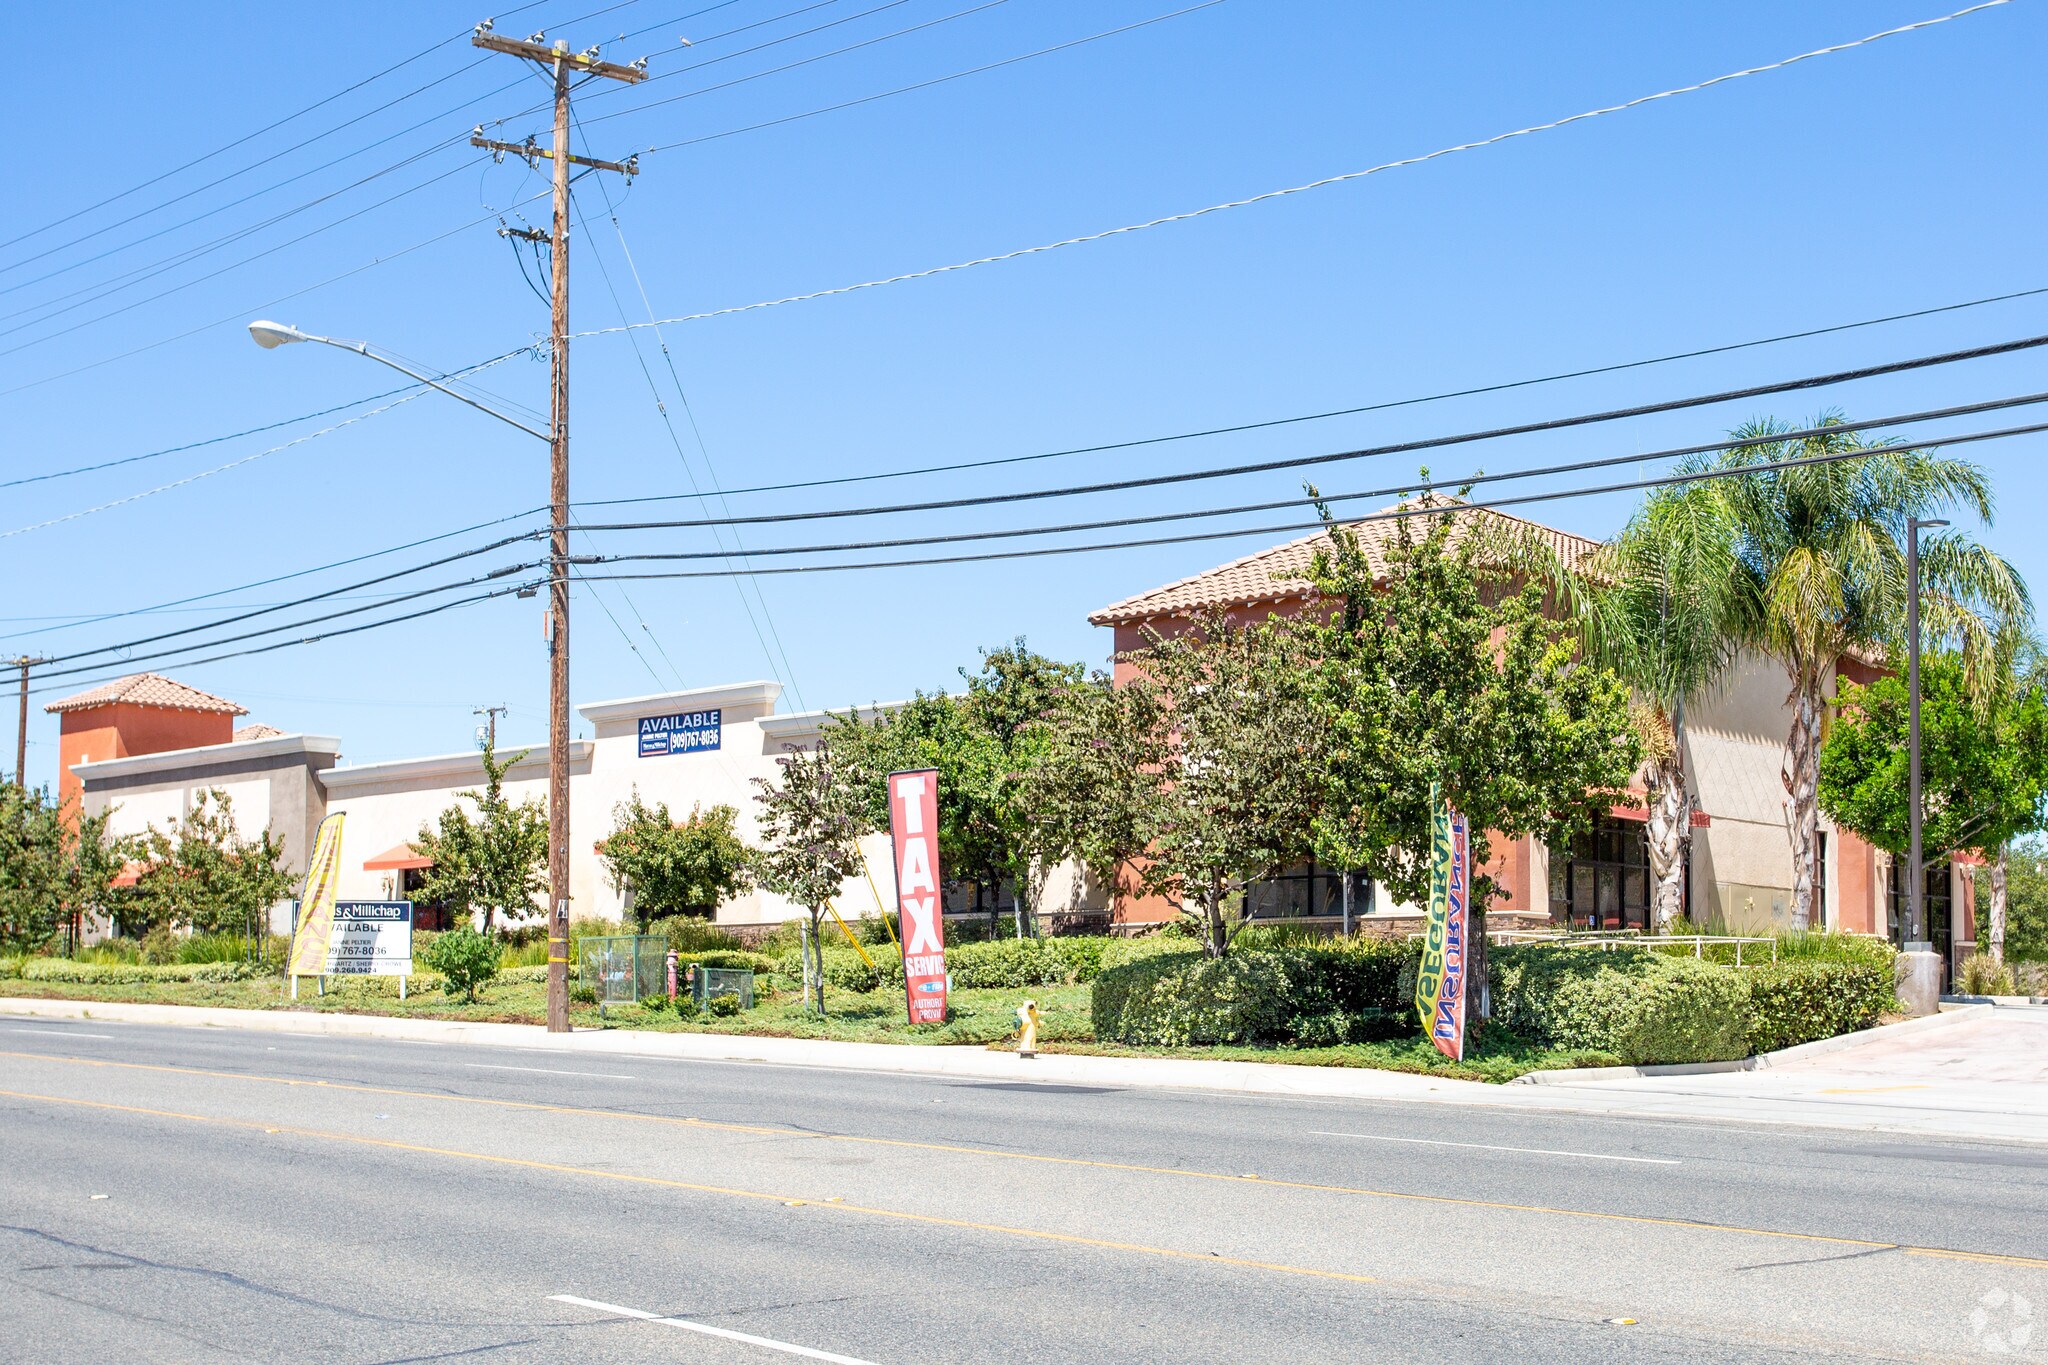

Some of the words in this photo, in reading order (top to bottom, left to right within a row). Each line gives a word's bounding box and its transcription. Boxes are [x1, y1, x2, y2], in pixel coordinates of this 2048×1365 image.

[641, 711, 718, 733] AVAILABLE
[897, 776, 944, 954] TAX
[352, 904, 401, 918] Millichap
[343, 946, 387, 955] 767-8036
[905, 954, 944, 977] SERVIC
